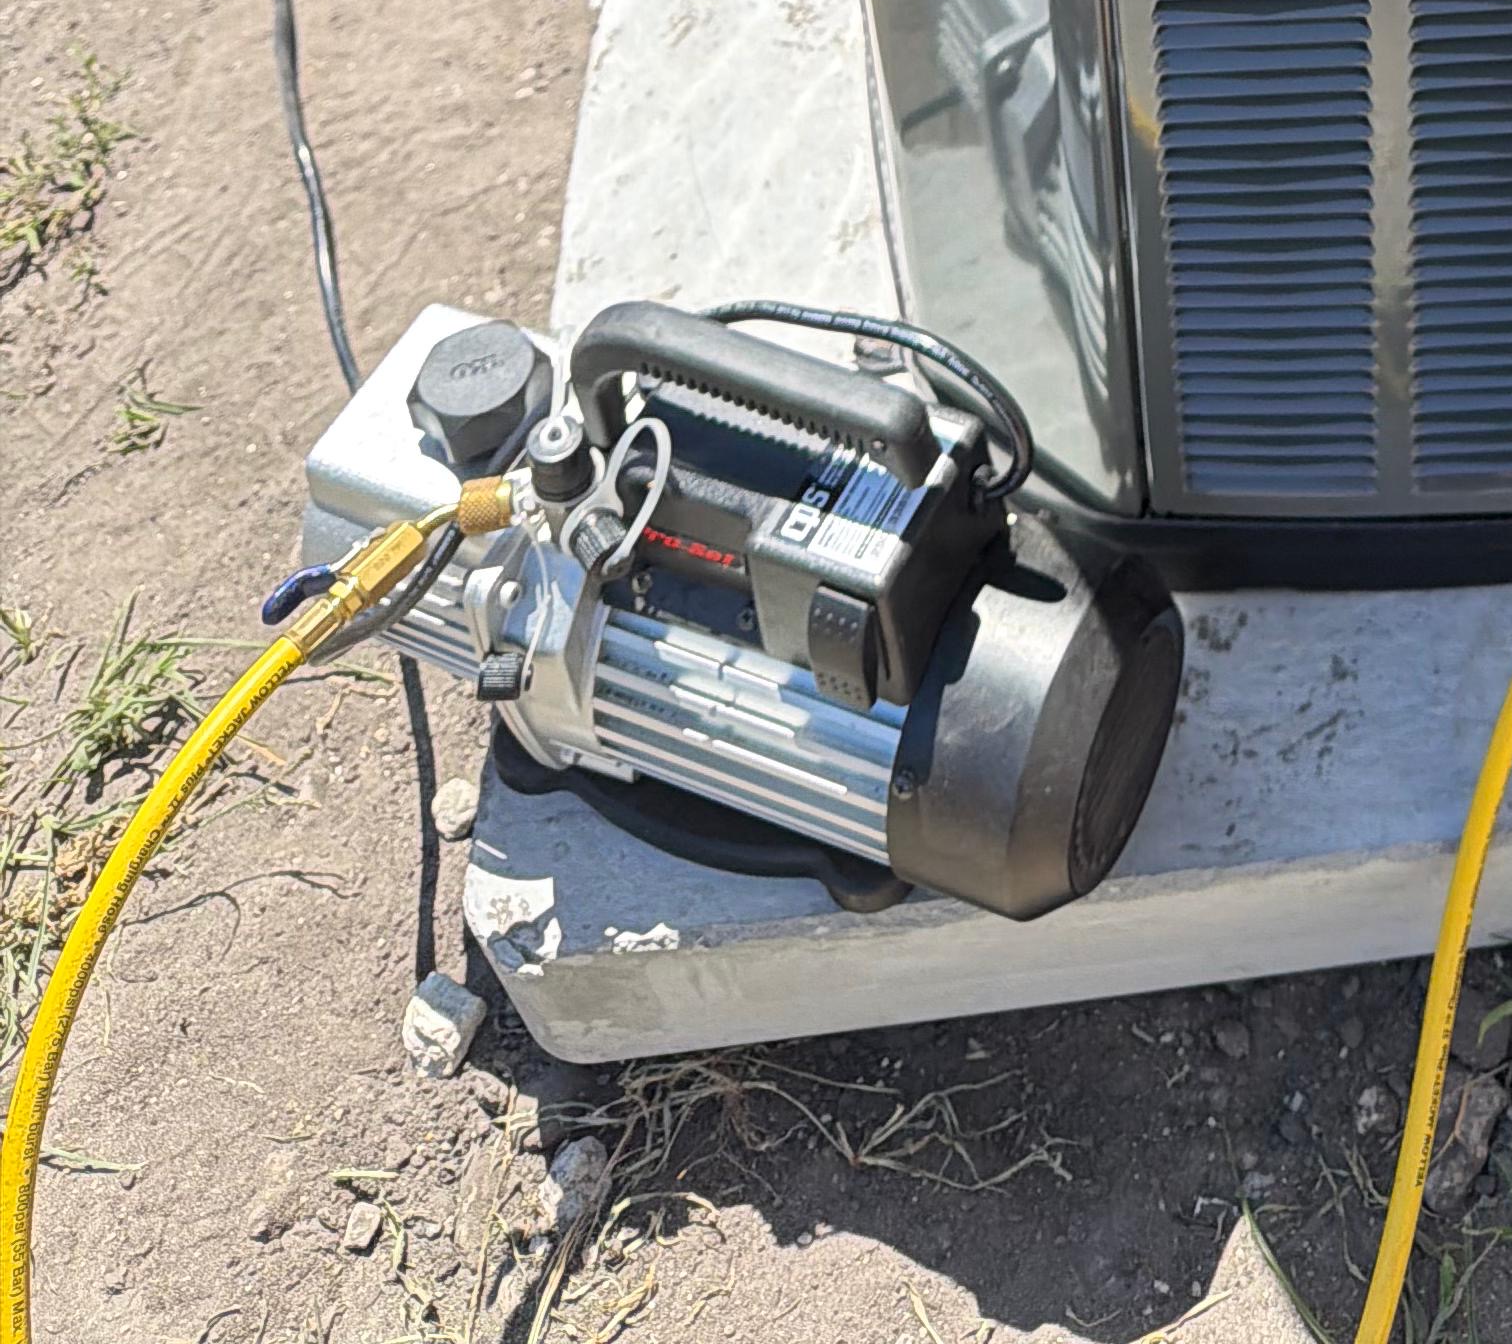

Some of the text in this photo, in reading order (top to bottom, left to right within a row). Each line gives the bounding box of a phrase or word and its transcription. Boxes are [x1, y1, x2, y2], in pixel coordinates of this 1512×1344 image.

[250, 660, 297, 710] YELLOW
[181, 763, 209, 794] Plus
[116, 827, 163, 894] Charging
[97, 896, 126, 935] Hose
[65, 952, 96, 1011] 4000psi
[52, 1013, 72, 1050] (275
[36, 1051, 59, 1082] Bar)
[23, 1121, 42, 1162] burst
[1415, 1133, 1432, 1188] YELLOW
[13, 1183, 32, 1235] 800psi
[10, 1238, 26, 1262] (55
[9, 1265, 25, 1298] Bar)
